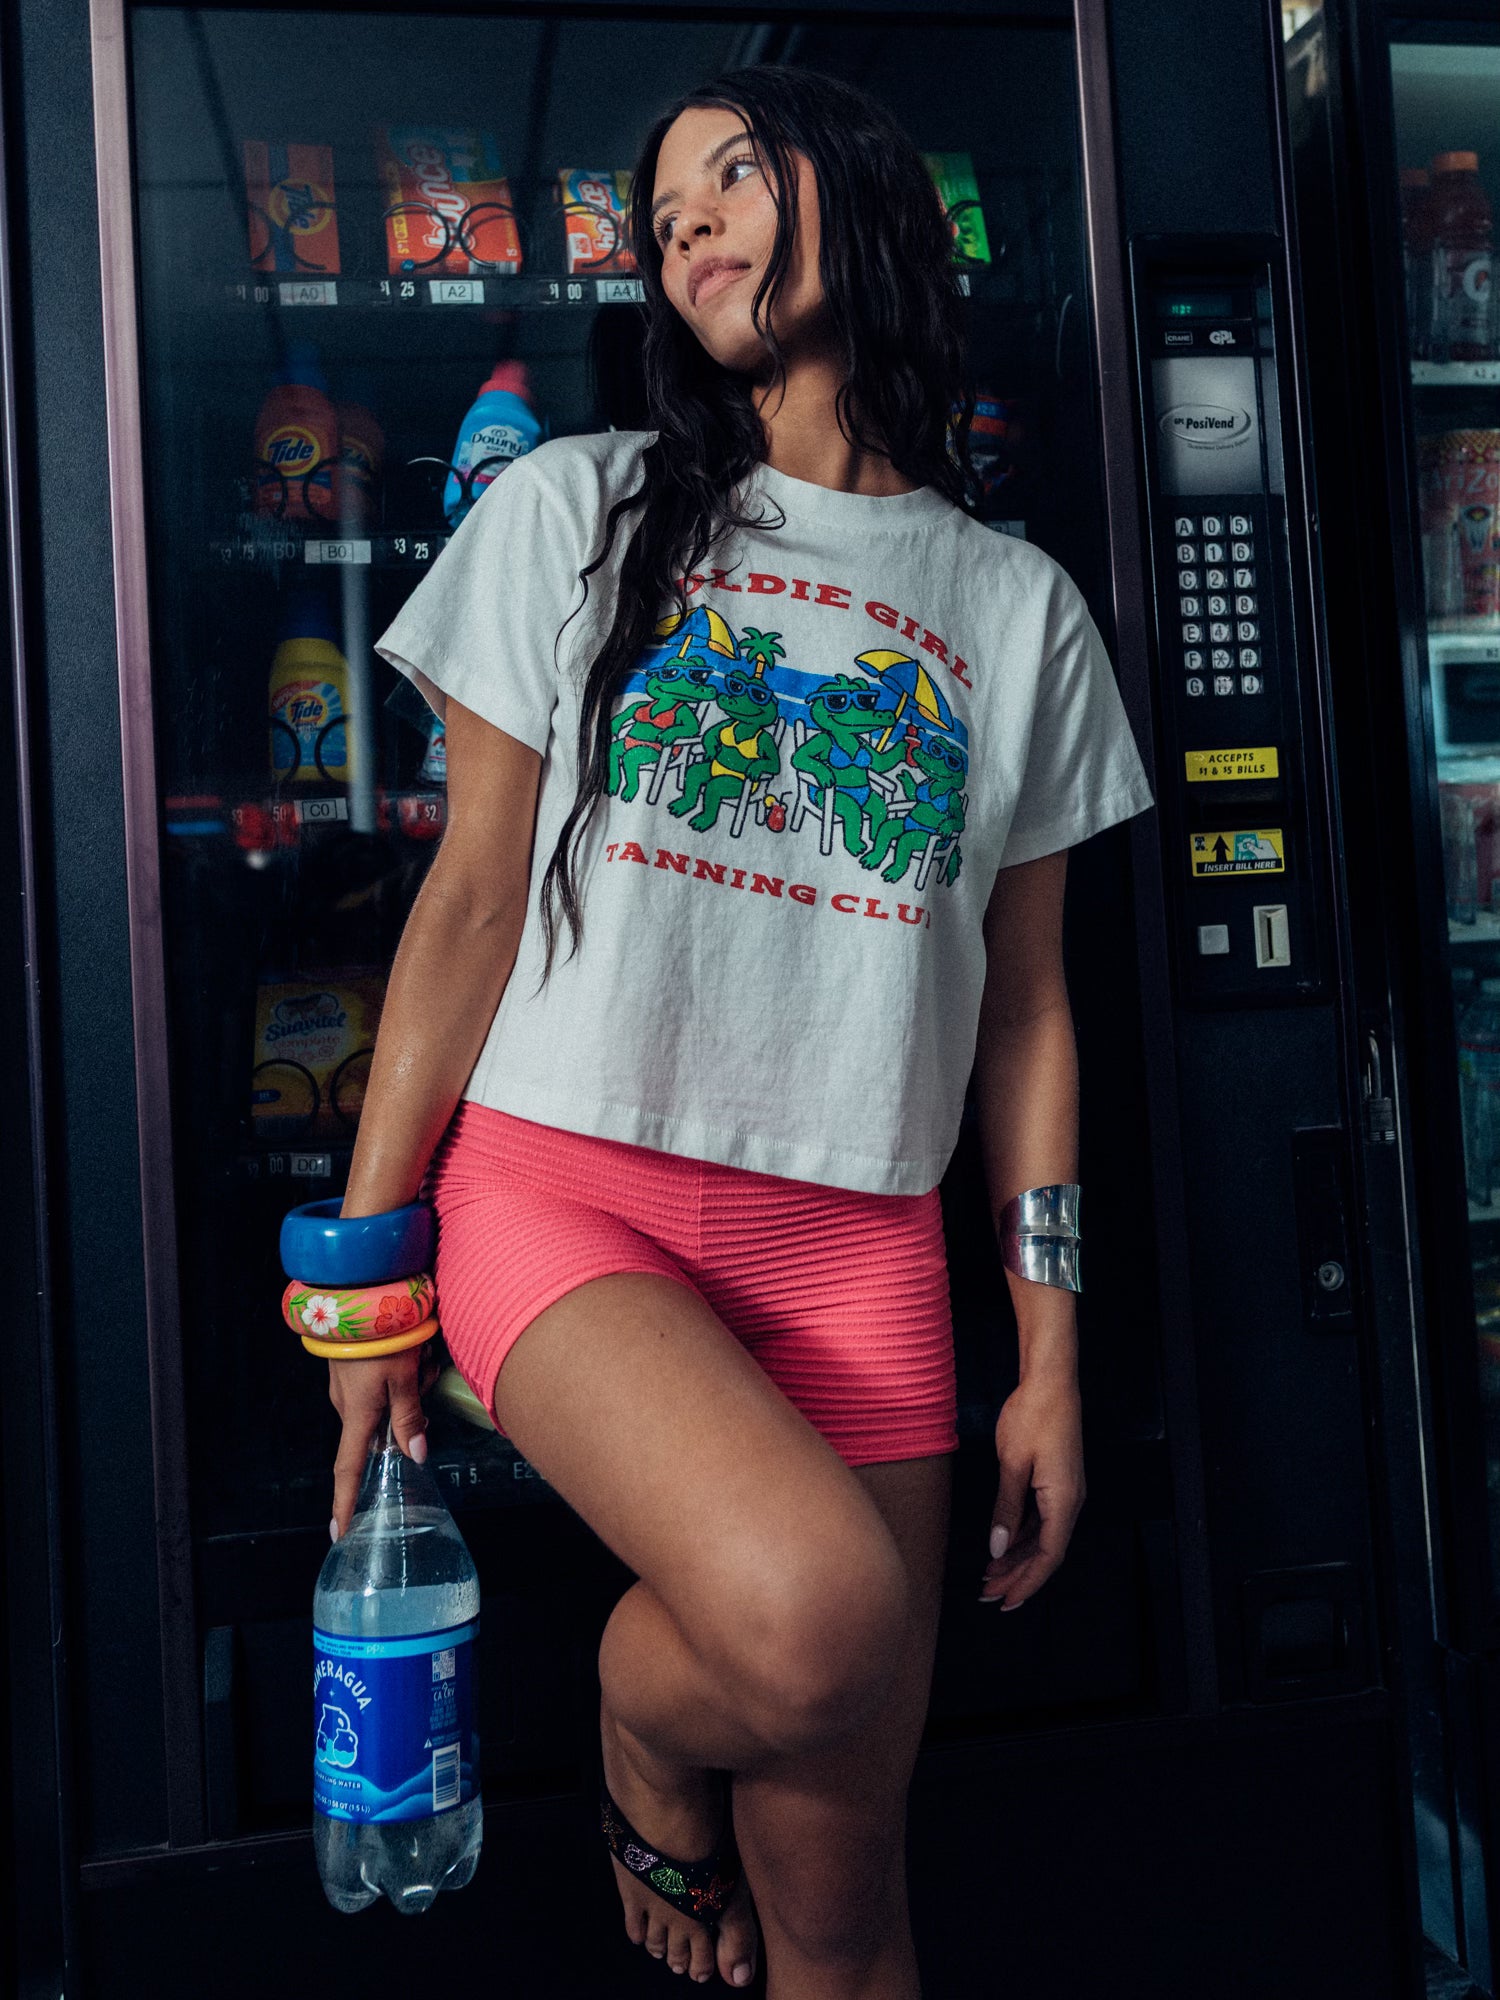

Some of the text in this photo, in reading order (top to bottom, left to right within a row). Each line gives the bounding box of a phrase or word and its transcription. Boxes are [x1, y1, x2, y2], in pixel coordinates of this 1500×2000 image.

[300, 286, 319, 300] A0
[380, 280, 415, 298] $1 25
[447, 285, 467, 298] A2
[549, 283, 583, 301] $1 00
[612, 286, 631, 297] A4
[1186, 416, 1235, 429] PosiVend
[268, 437, 315, 466] Tide
[471, 432, 523, 456] Downy
[1179, 518, 1244, 534] A 0 5
[327, 545, 347, 559] B0
[394, 538, 430, 560] $3 25
[1181, 546, 1191, 560] B
[1236, 545, 1245, 559] 6
[1183, 571, 1247, 587] C 2 7
[1185, 598, 1249, 614] D 3 8
[674, 568, 973, 690] OLDIE GIRL
[1187, 624, 1251, 640] E 4 9
[1189, 653, 1197, 666] F
[1190, 680, 1199, 694] G
[1246, 678, 1255, 692] J
[291, 700, 324, 722] Tide
[1208, 753, 1254, 764] ACCEPTS
[1199, 764, 1266, 776] $1 & $5 BILLS
[231, 806, 288, 826] $3 50
[309, 804, 331, 818] C0
[425, 804, 437, 821] $2
[1204, 860, 1277, 873] INSERT BILL HERE
[606, 841, 931, 930] TANNING CLU
[297, 1158, 318, 1172] D0
[338, 1779, 361, 1789] WATER
